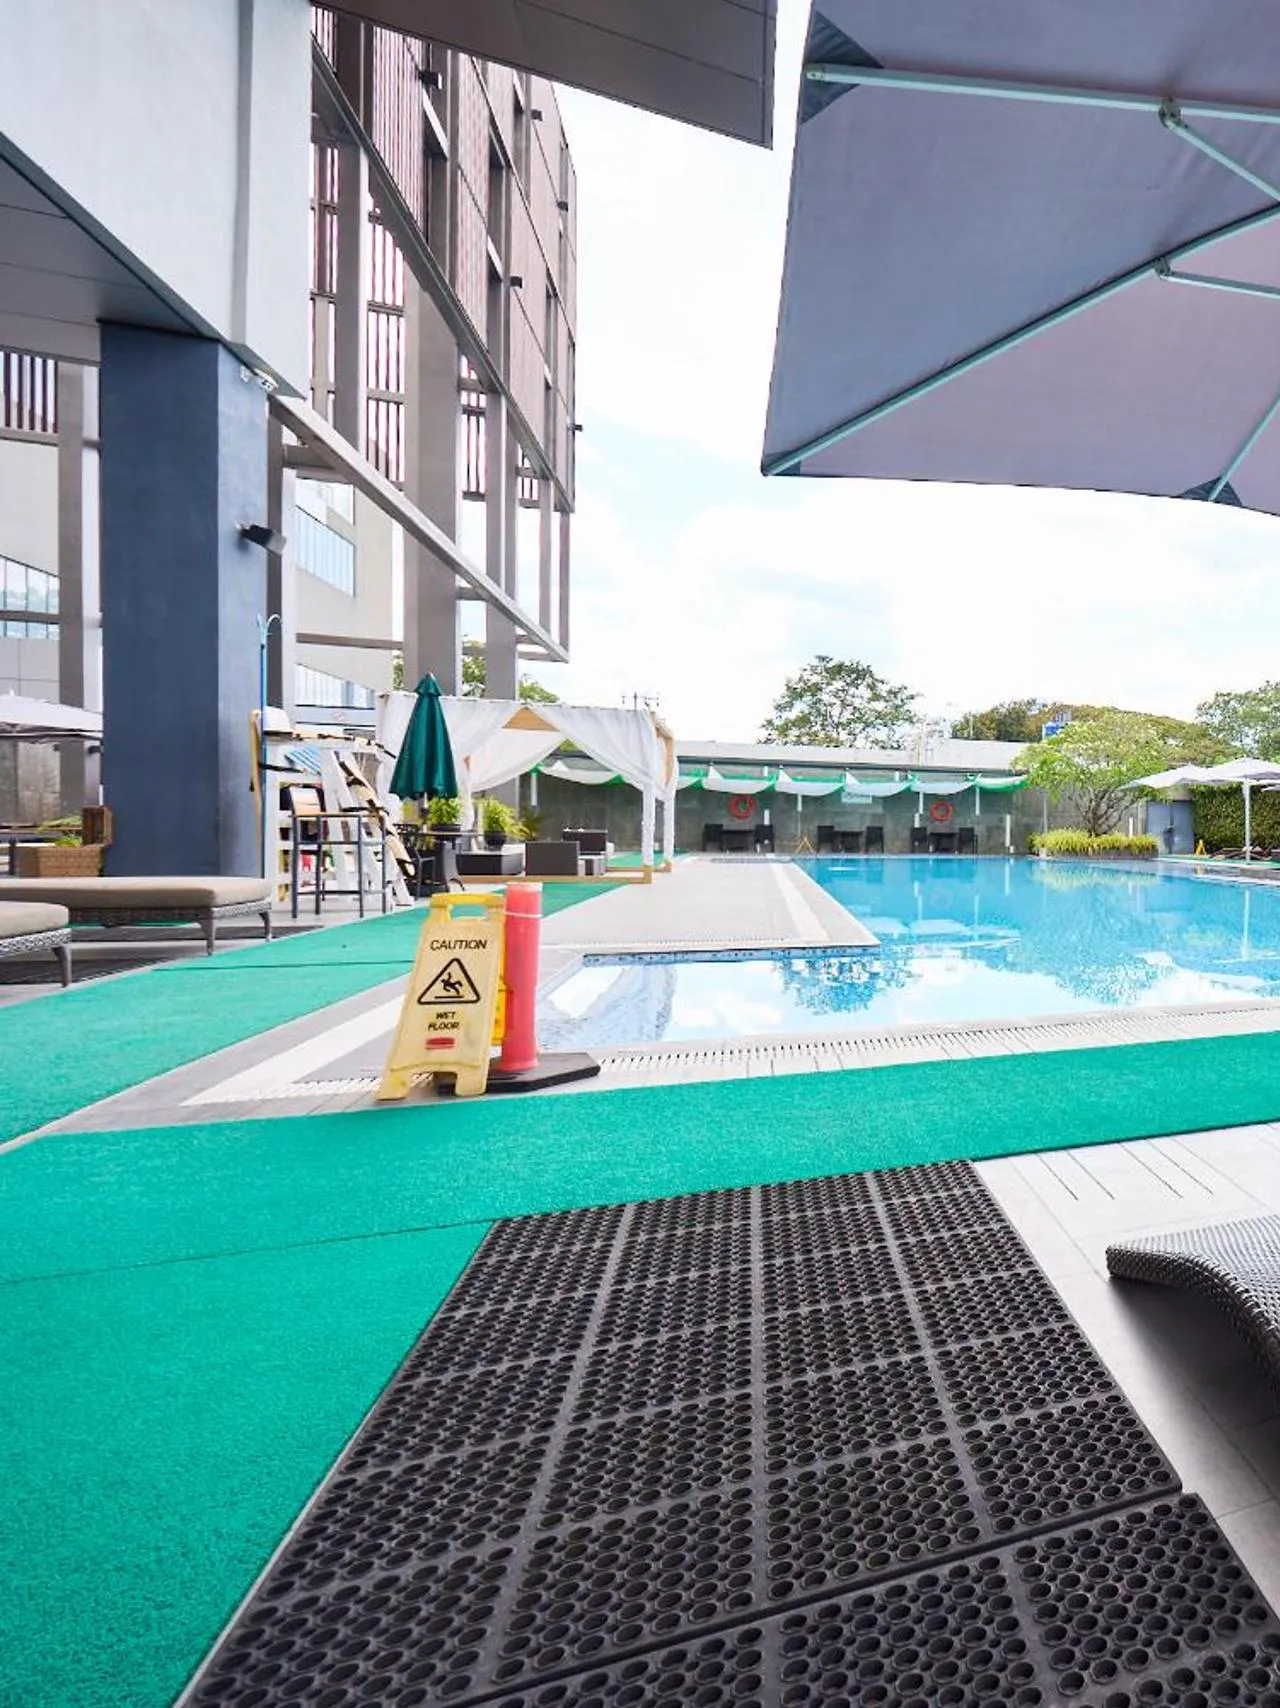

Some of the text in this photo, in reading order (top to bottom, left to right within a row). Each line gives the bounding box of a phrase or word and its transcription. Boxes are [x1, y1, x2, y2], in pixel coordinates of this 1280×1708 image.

[430, 939, 487, 950] CAUTION
[436, 1011, 455, 1019] WET
[428, 1021, 460, 1031] FLOOR
